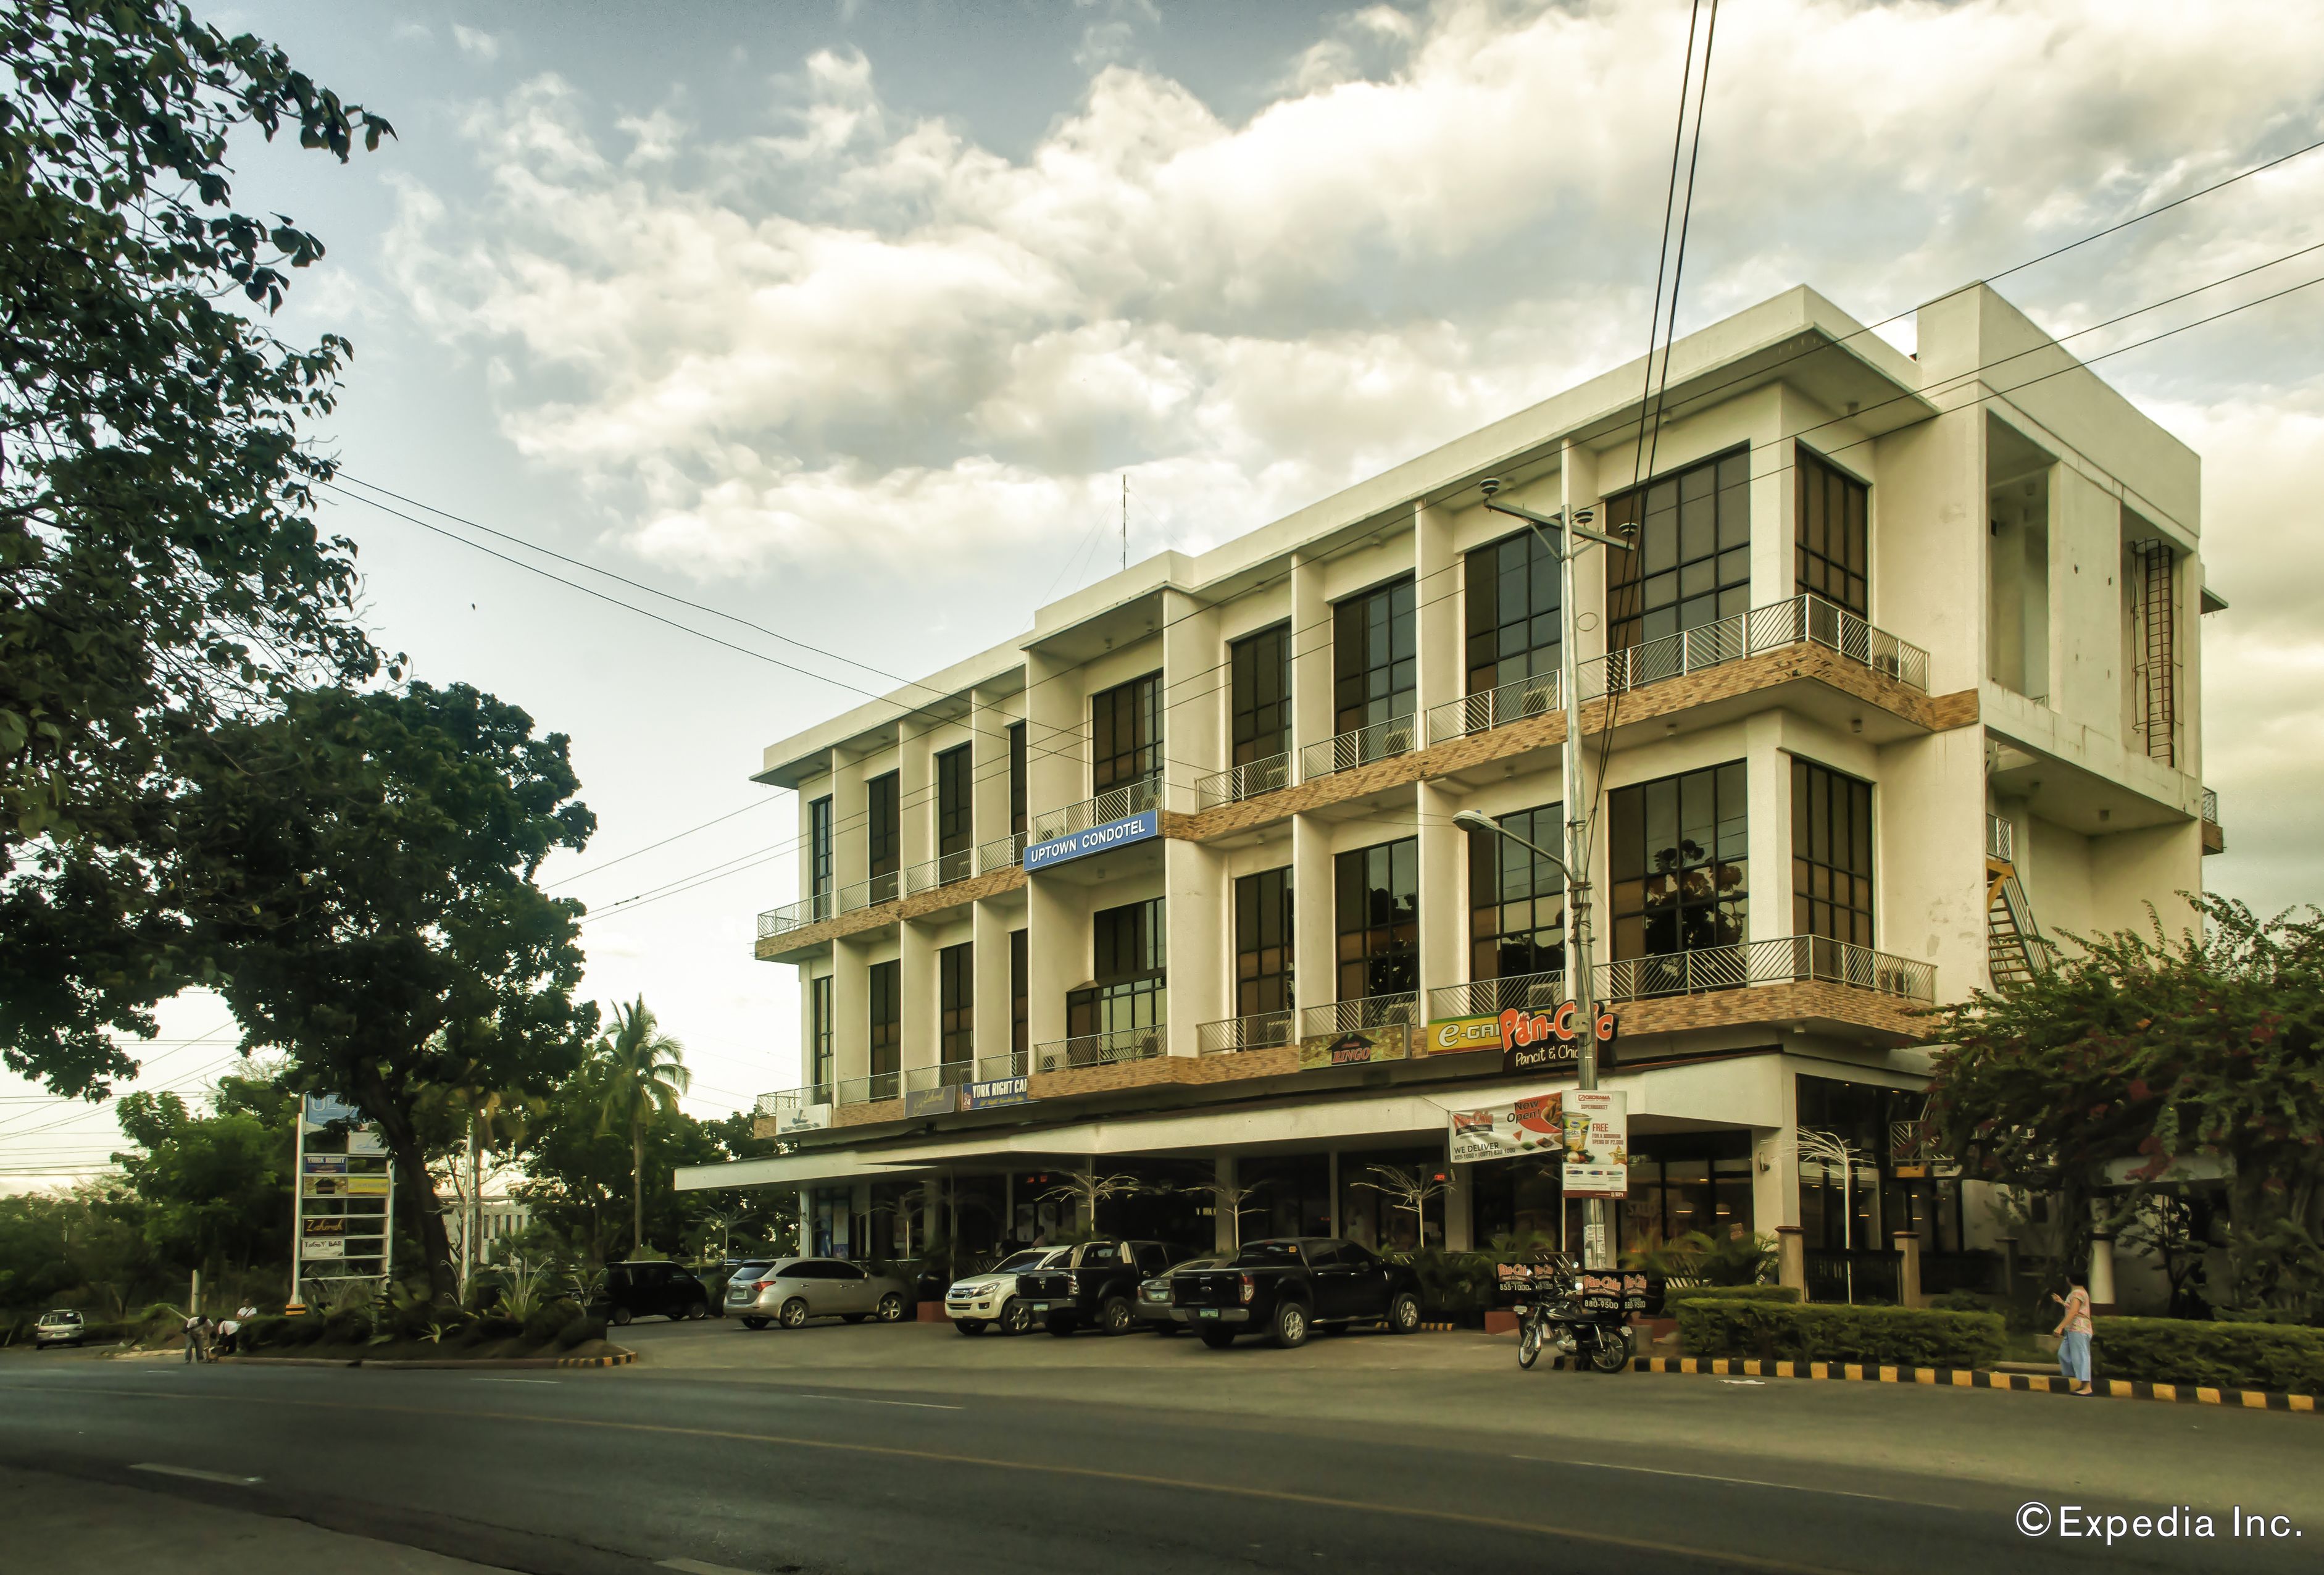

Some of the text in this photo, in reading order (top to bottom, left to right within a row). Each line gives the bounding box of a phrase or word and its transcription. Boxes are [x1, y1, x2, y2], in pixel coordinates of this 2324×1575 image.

[1031, 819, 1146, 863] UPTOWN CONDOTEL
[1438, 1022, 1500, 1047] e-GA
[1332, 1047, 1370, 1063] BINGO
[1515, 1047, 1546, 1067] Pancit
[1549, 1048, 1556, 1059] &
[972, 1084, 991, 1098] YORK
[991, 1080, 1013, 1097] RIGHT
[964, 1098, 971, 1106] 24
[1514, 1100, 1539, 1111] Now
[1507, 1109, 1541, 1124] Open!
[1593, 1123, 1609, 1132] FREE
[1454, 1142, 1499, 1154] WE DELIVER
[1585, 1300, 1618, 1309] 880-9500
